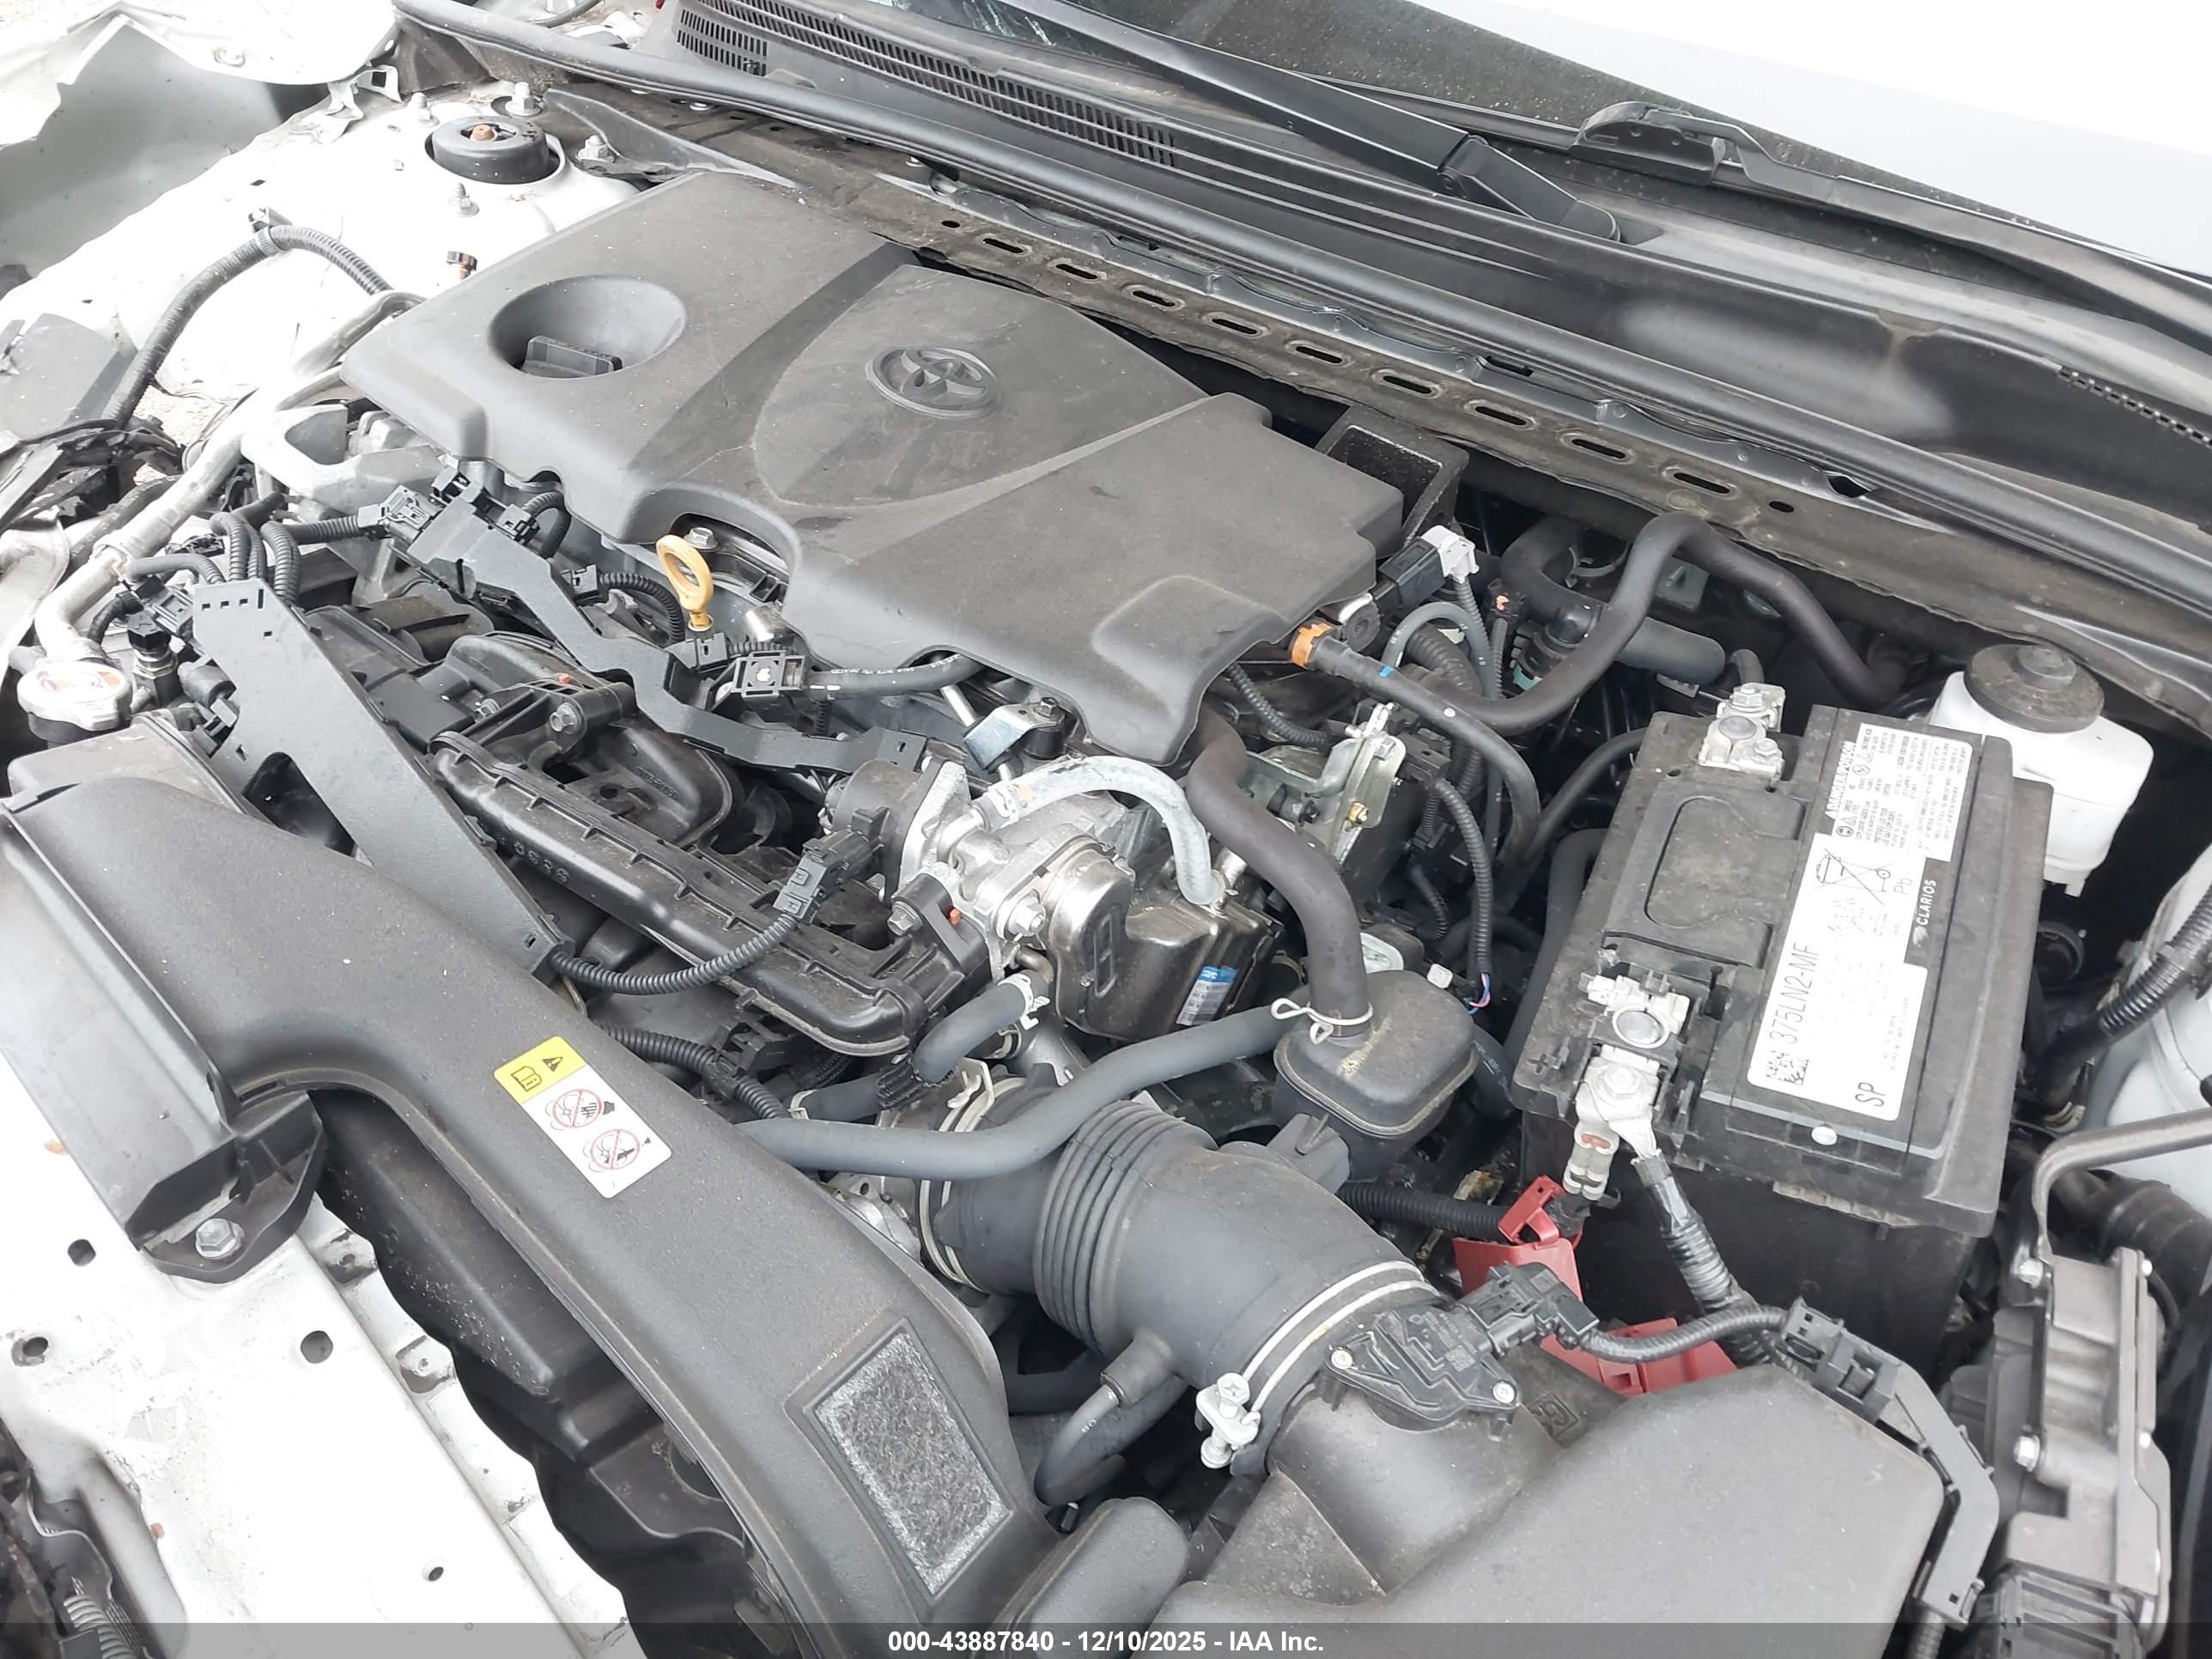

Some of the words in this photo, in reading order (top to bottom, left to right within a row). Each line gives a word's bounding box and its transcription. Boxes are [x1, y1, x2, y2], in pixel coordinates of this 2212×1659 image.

[1893, 878, 1913, 894] Pb
[1916, 879, 1936, 927] CLARIOS
[1769, 942, 1819, 1044] 375LN2-MF
[1855, 1082, 1886, 1107] SP
